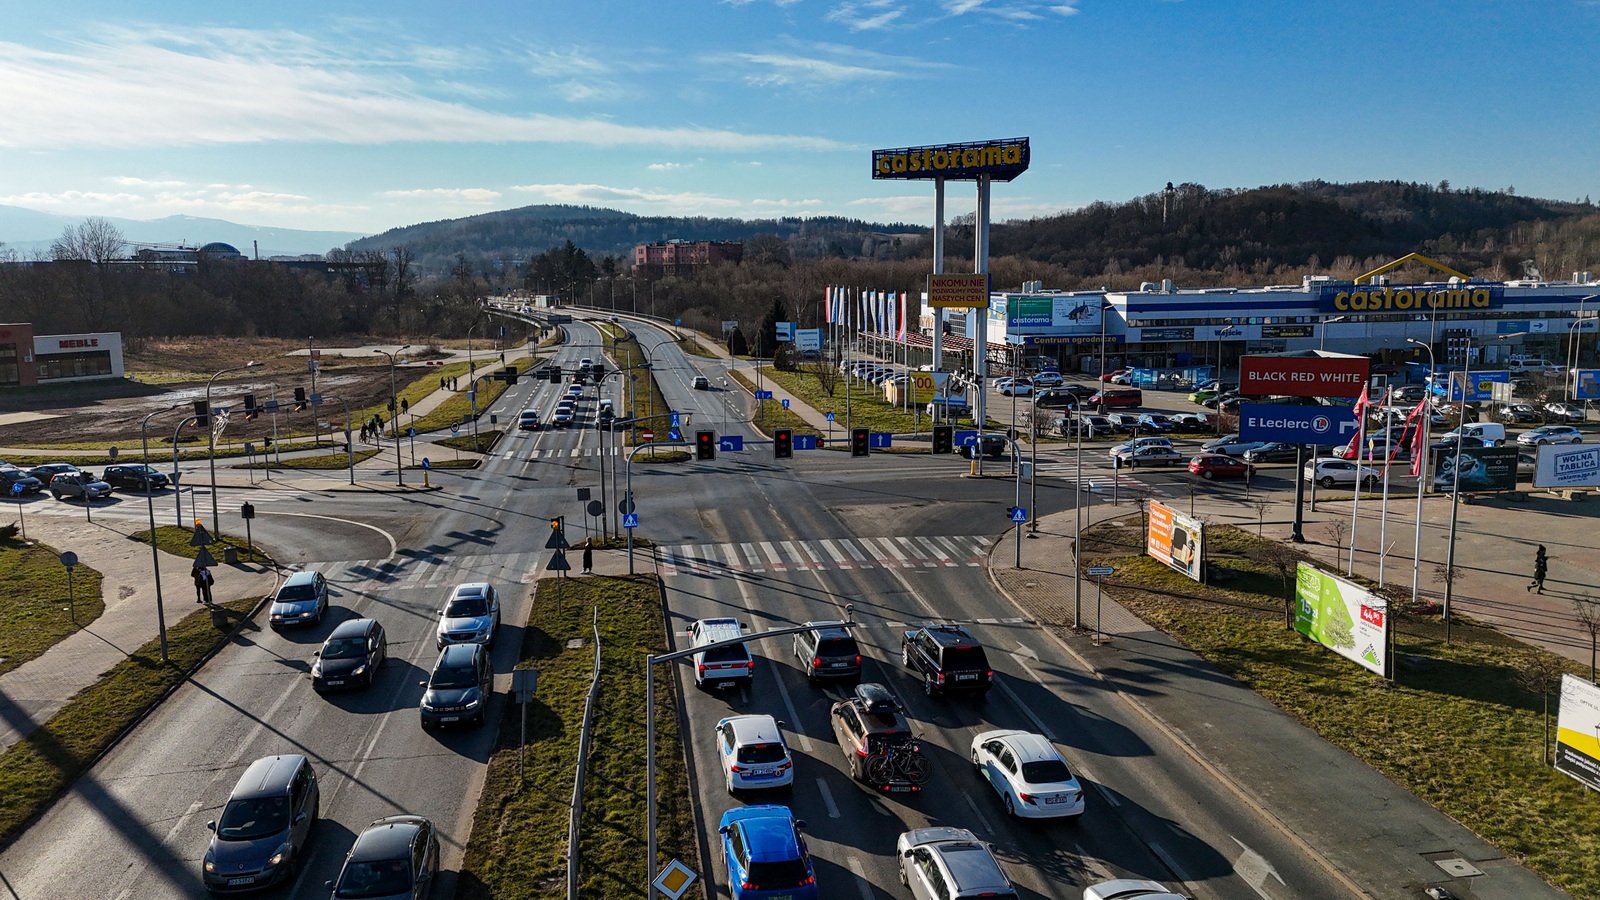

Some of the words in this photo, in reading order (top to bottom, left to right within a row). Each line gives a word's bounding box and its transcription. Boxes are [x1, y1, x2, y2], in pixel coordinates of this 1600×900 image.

[879, 145, 1021, 174] castorama
[932, 279, 968, 288] NIKOMU
[970, 279, 985, 288] NIE
[1334, 286, 1490, 311] castorama
[59, 338, 99, 349] MEBLE
[1248, 371, 1287, 381] BLACK
[1291, 372, 1316, 382] RED
[1320, 373, 1361, 383] WHITE
[1562, 453, 1593, 463] WOLNA
[1560, 460, 1596, 471] TABLICA
[1301, 599, 1312, 615] 15
